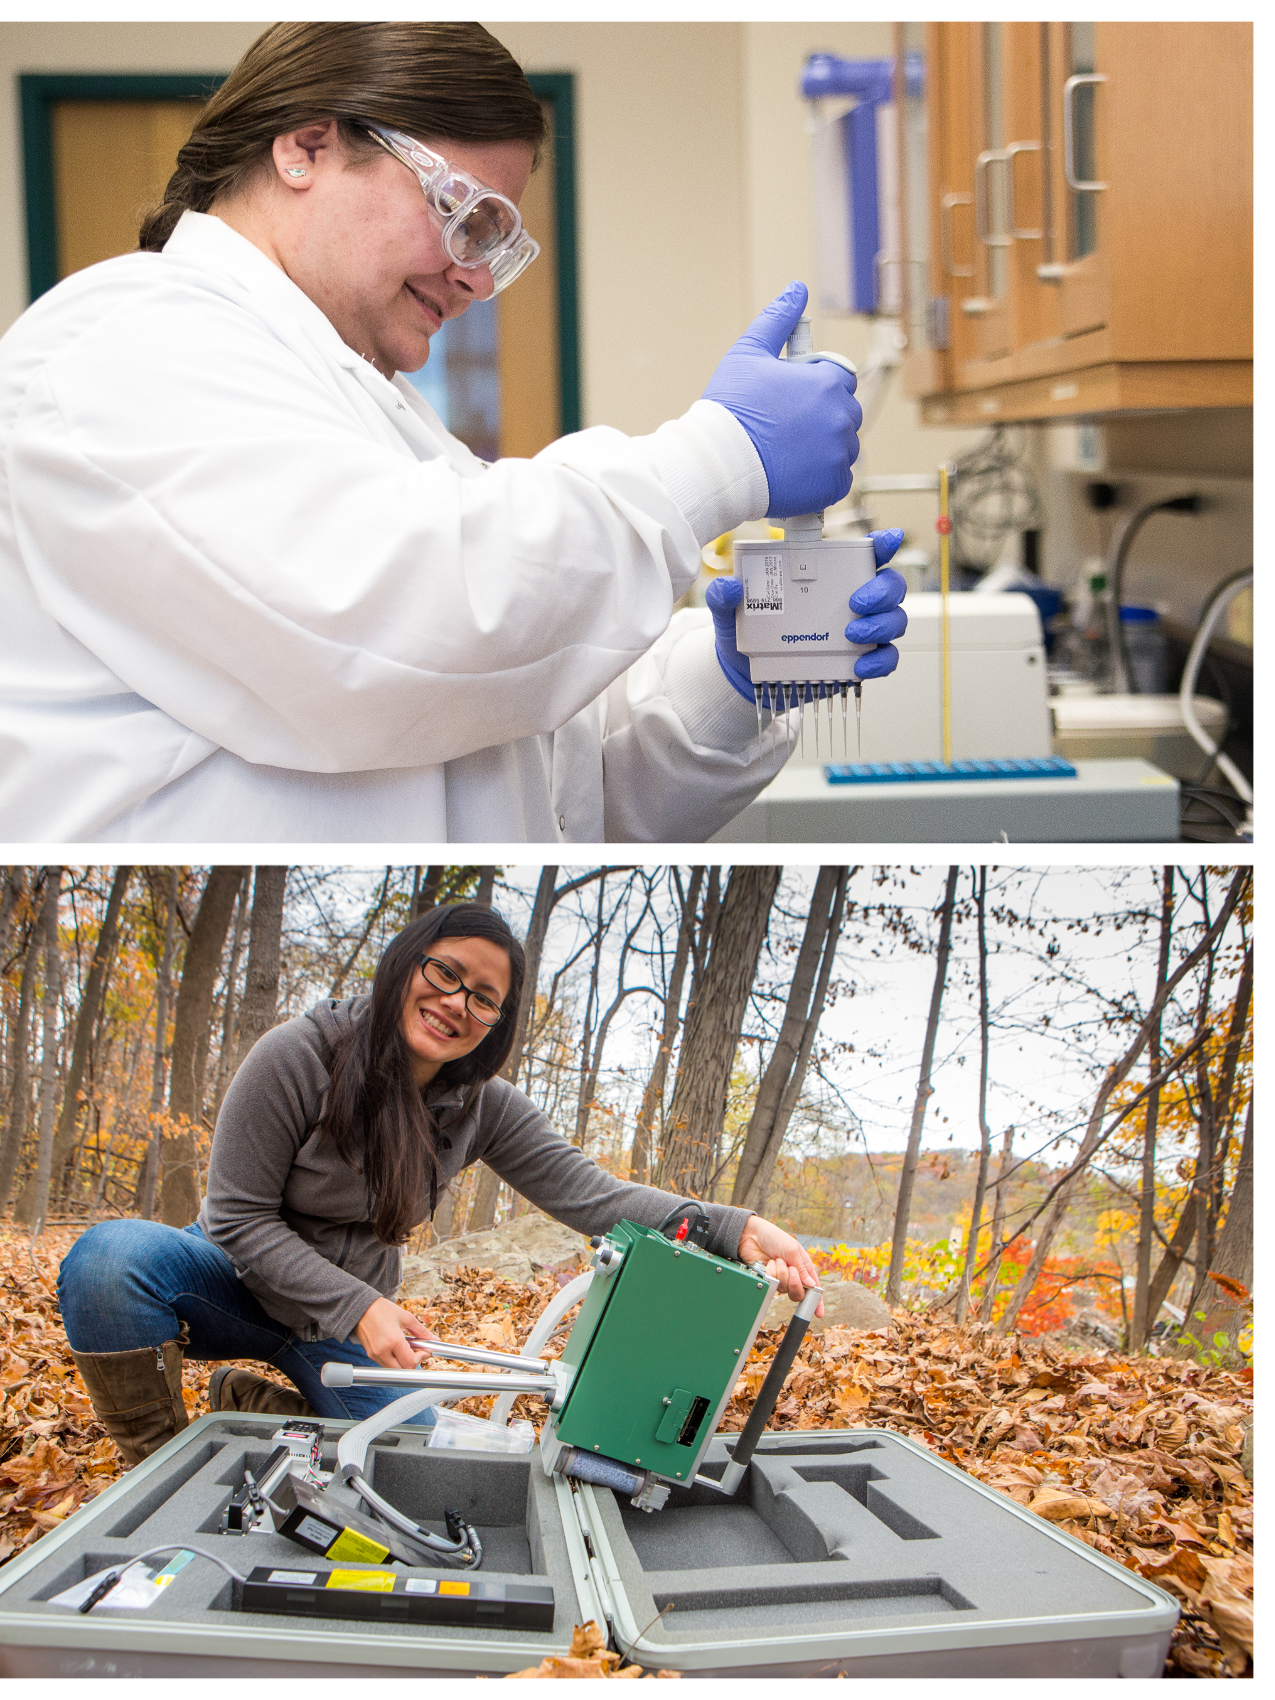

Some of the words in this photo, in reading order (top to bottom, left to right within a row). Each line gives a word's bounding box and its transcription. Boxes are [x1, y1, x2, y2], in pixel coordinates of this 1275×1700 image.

[800, 586, 809, 594] 10
[746, 602, 779, 611] Matrix
[781, 632, 830, 644] eppendorf
